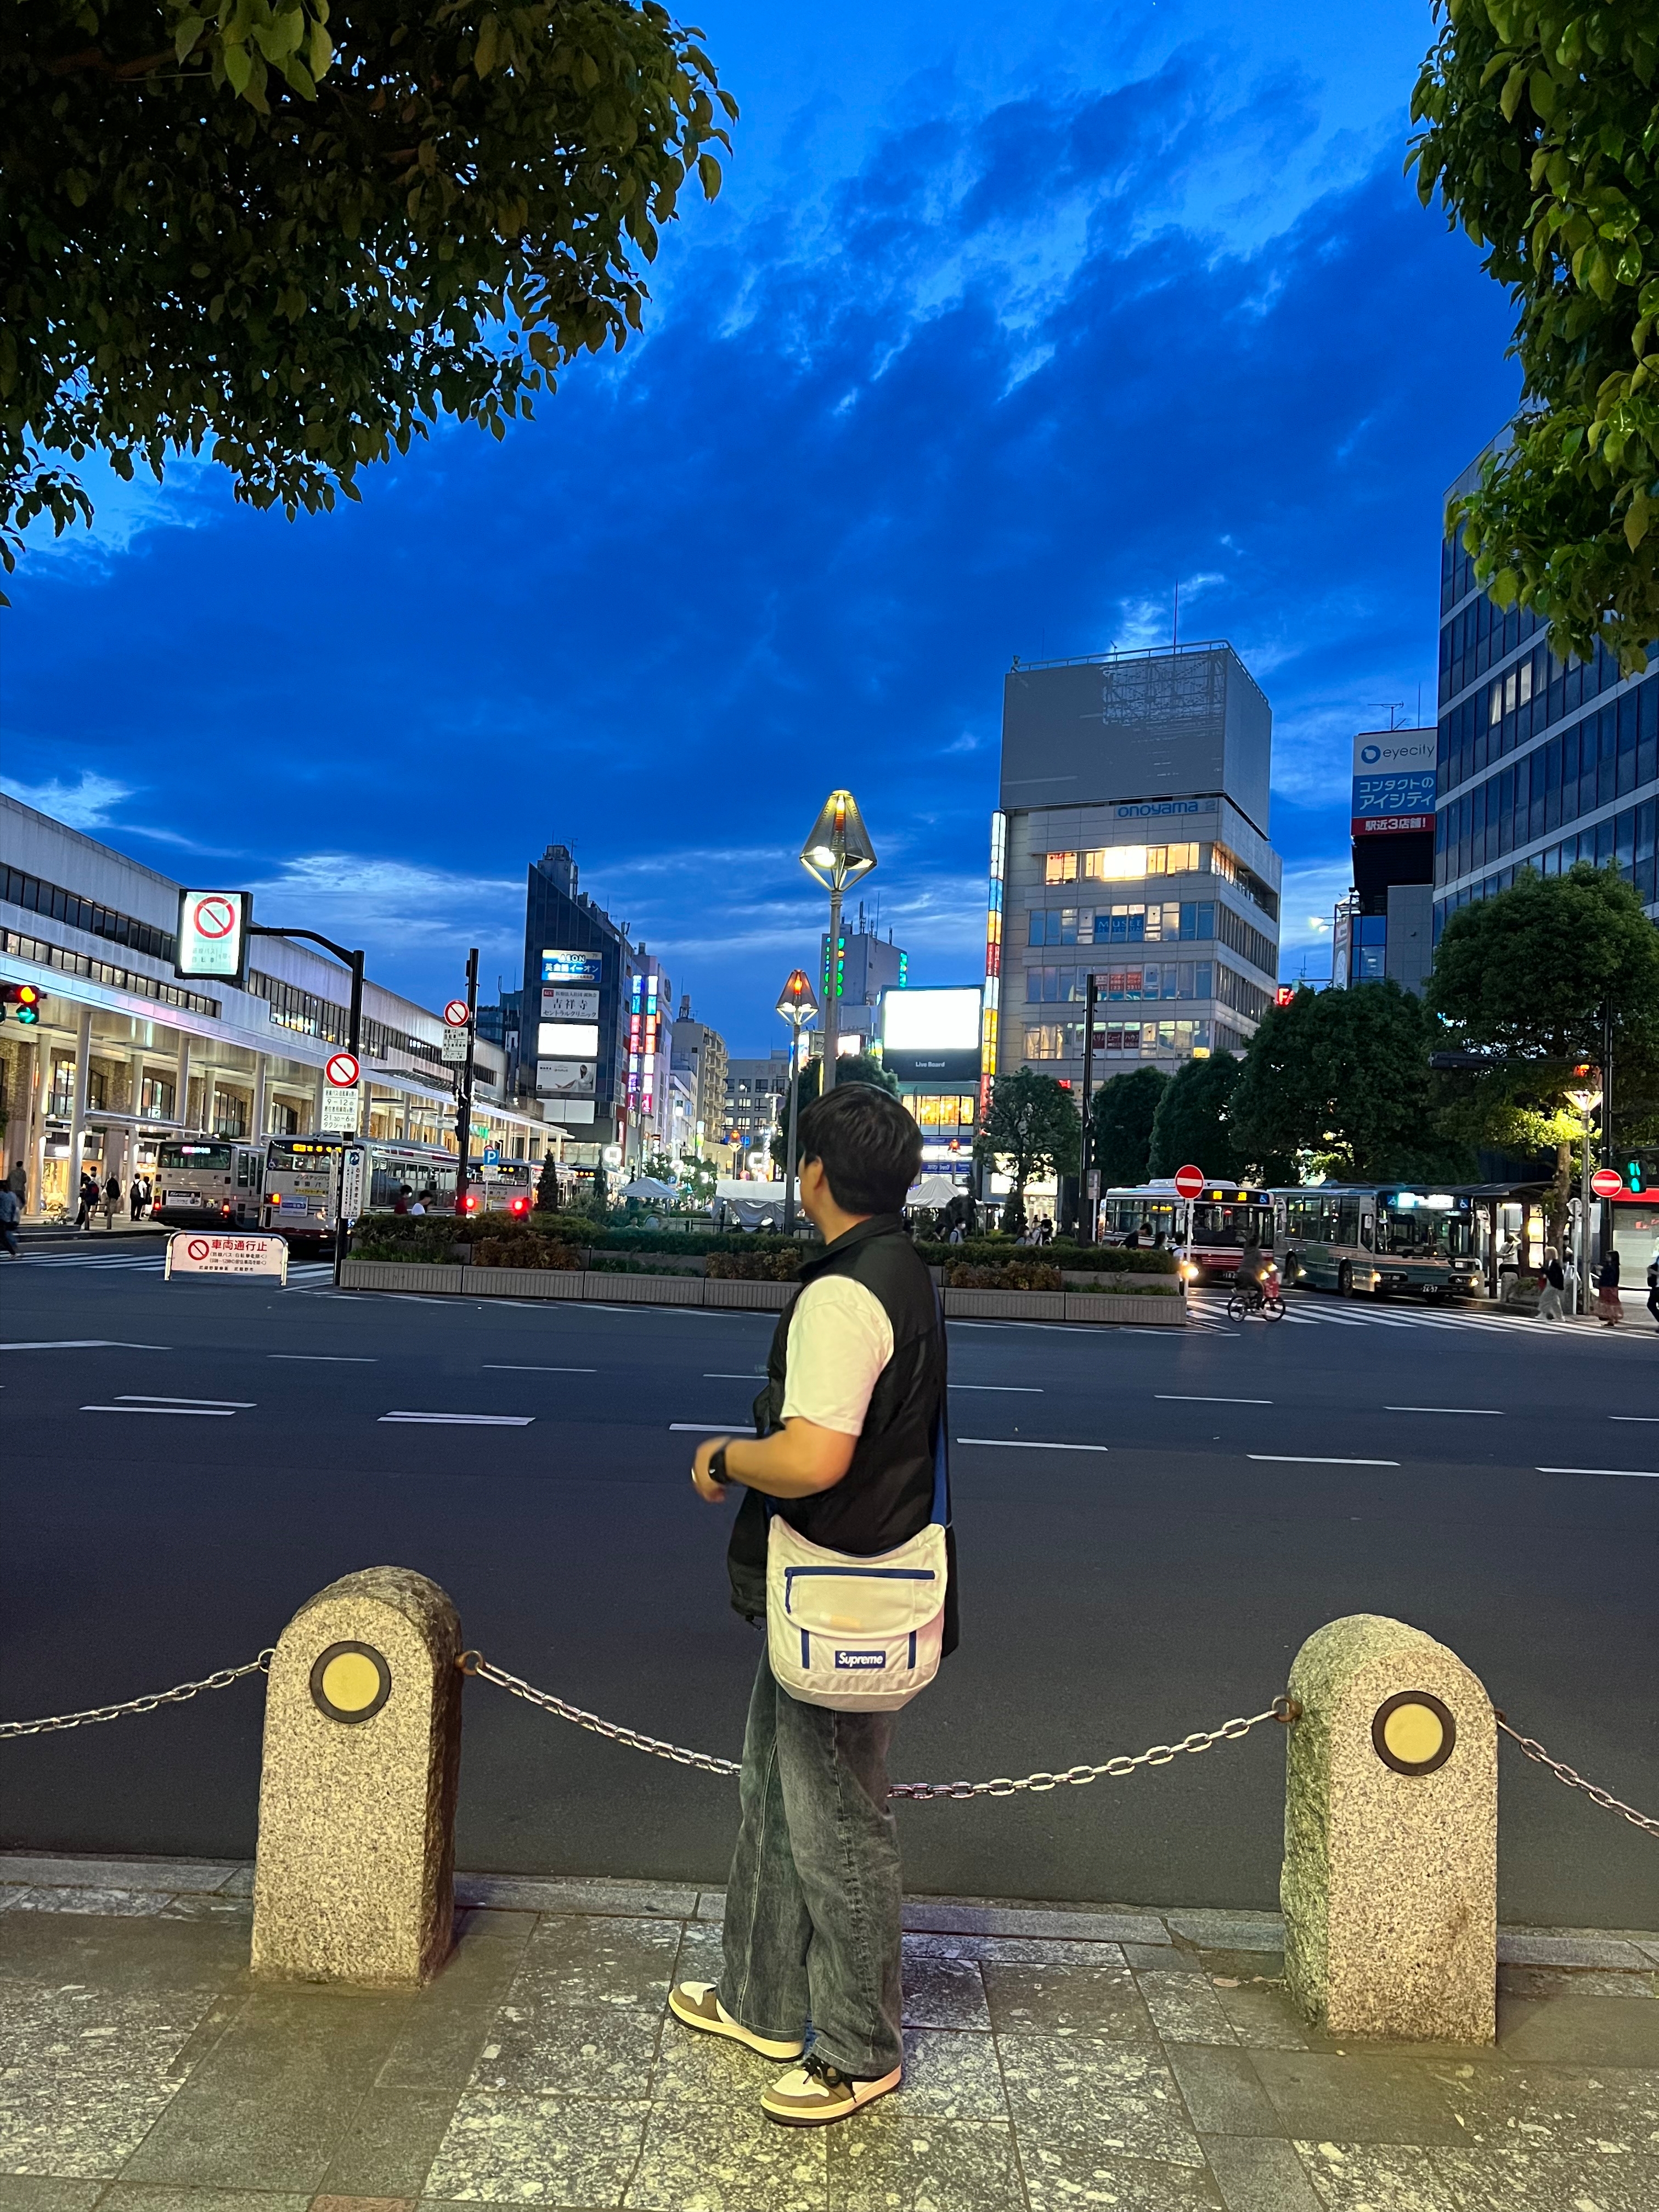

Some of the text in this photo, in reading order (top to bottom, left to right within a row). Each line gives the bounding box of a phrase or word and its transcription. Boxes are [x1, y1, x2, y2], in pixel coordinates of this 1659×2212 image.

[1383, 744, 1435, 760] eyecity
[1359, 777, 1434, 792] コンタクトの
[1359, 792, 1434, 810] アイシティ
[1118, 801, 1198, 817] onoyama
[559, 953, 586, 962] AEON
[553, 998, 588, 1010] 吉祥寺
[487, 1151, 496, 1163] P
[211, 1239, 268, 1251] 車両通行止
[838, 1652, 883, 1667] Supreme
